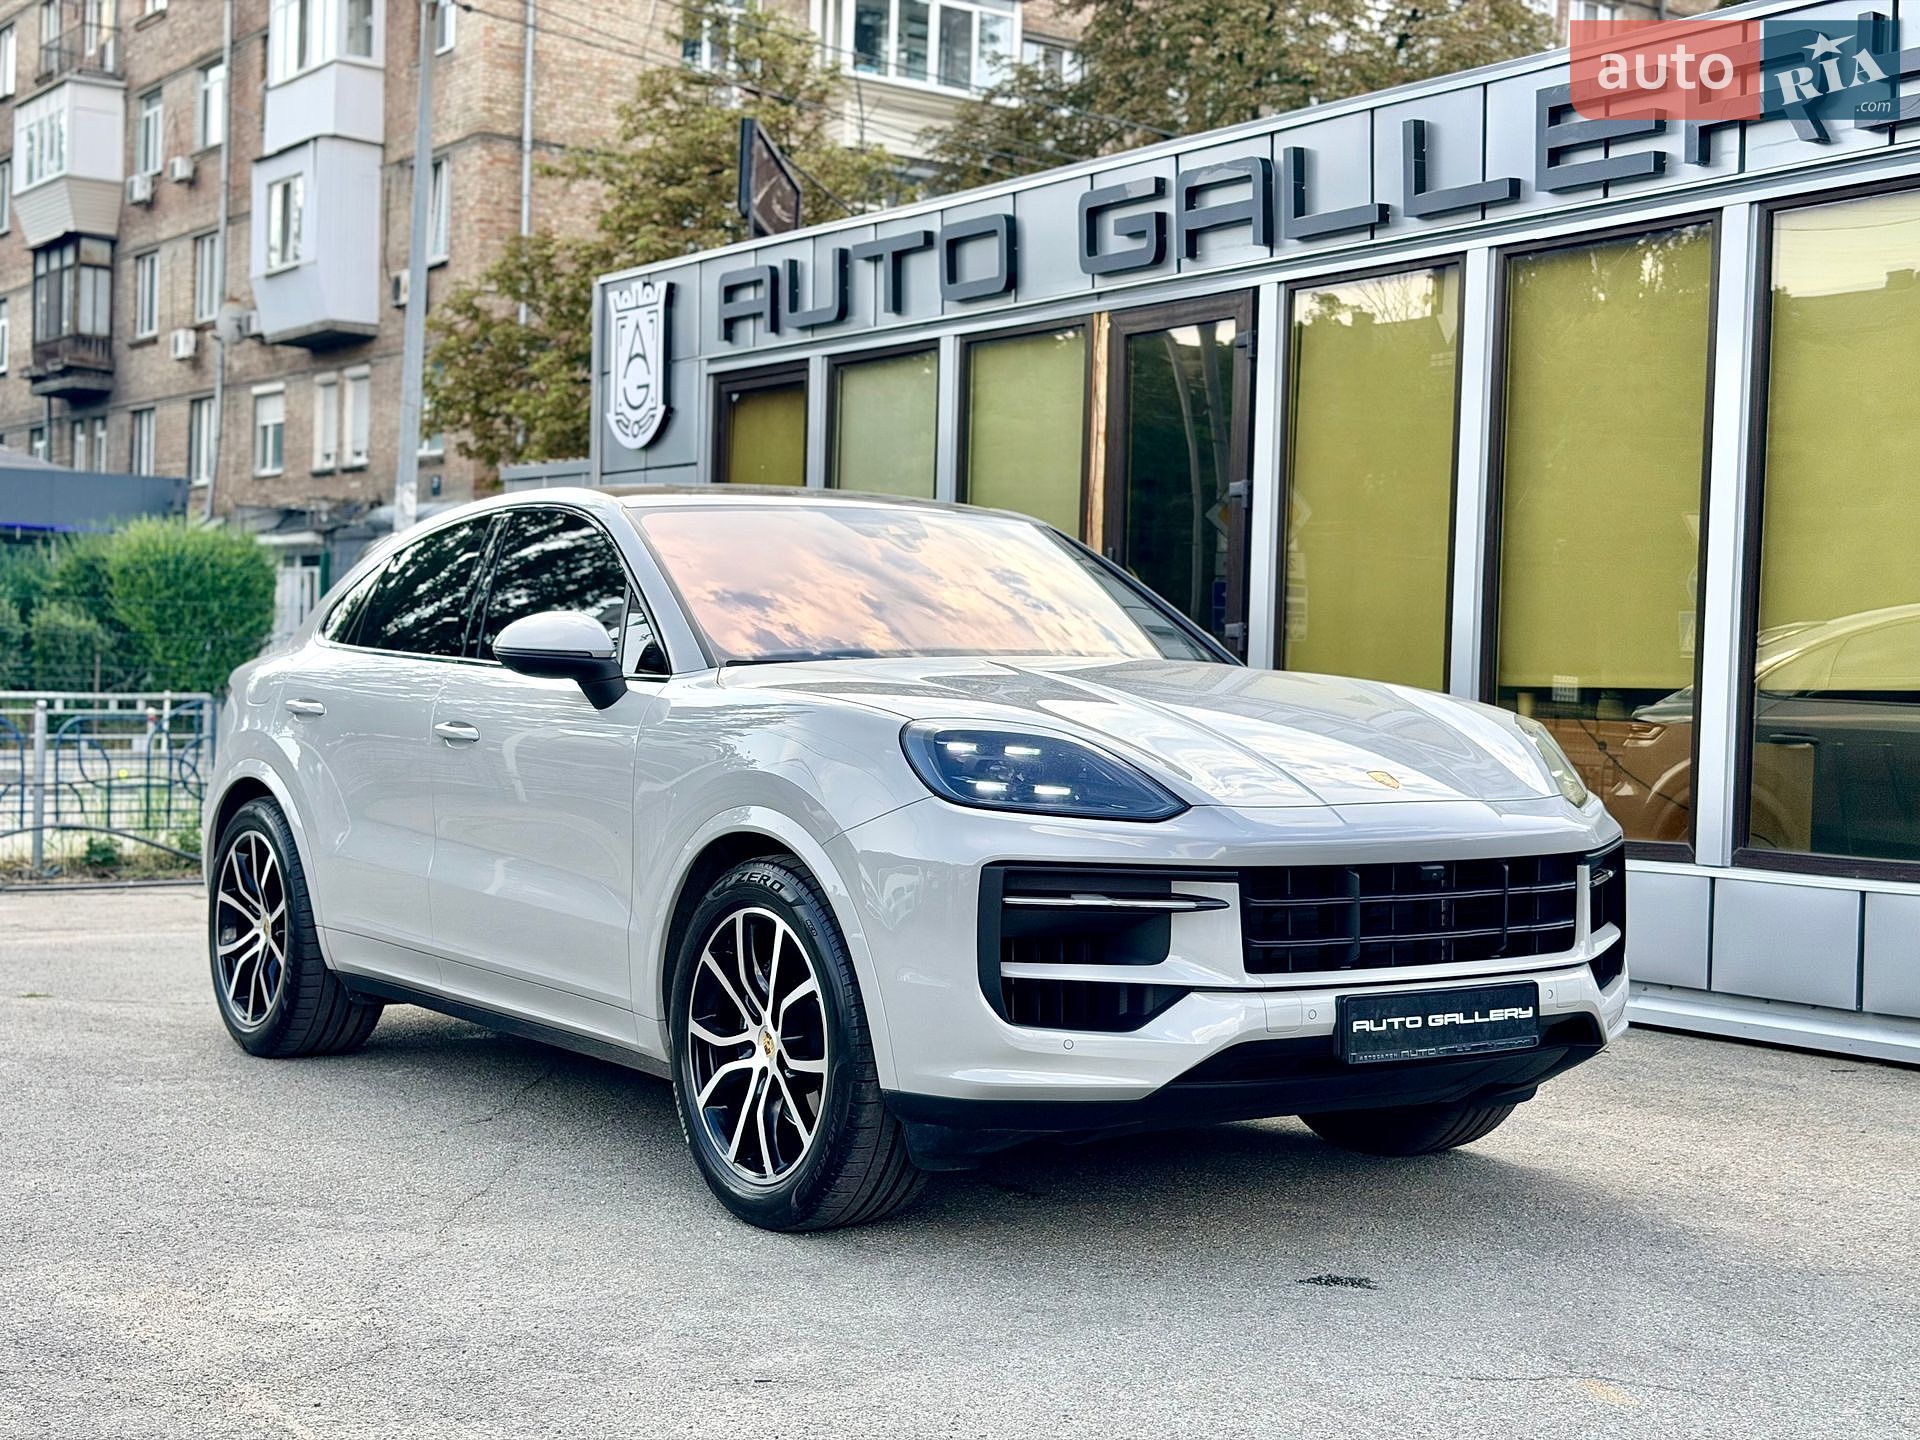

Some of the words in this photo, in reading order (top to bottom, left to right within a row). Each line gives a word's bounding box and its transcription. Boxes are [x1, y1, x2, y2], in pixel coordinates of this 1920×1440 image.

[718, 212, 1017, 343] AUTO
[1352, 1016, 1423, 1033] AUTO
[1427, 1006, 1534, 1027] GALLERY
